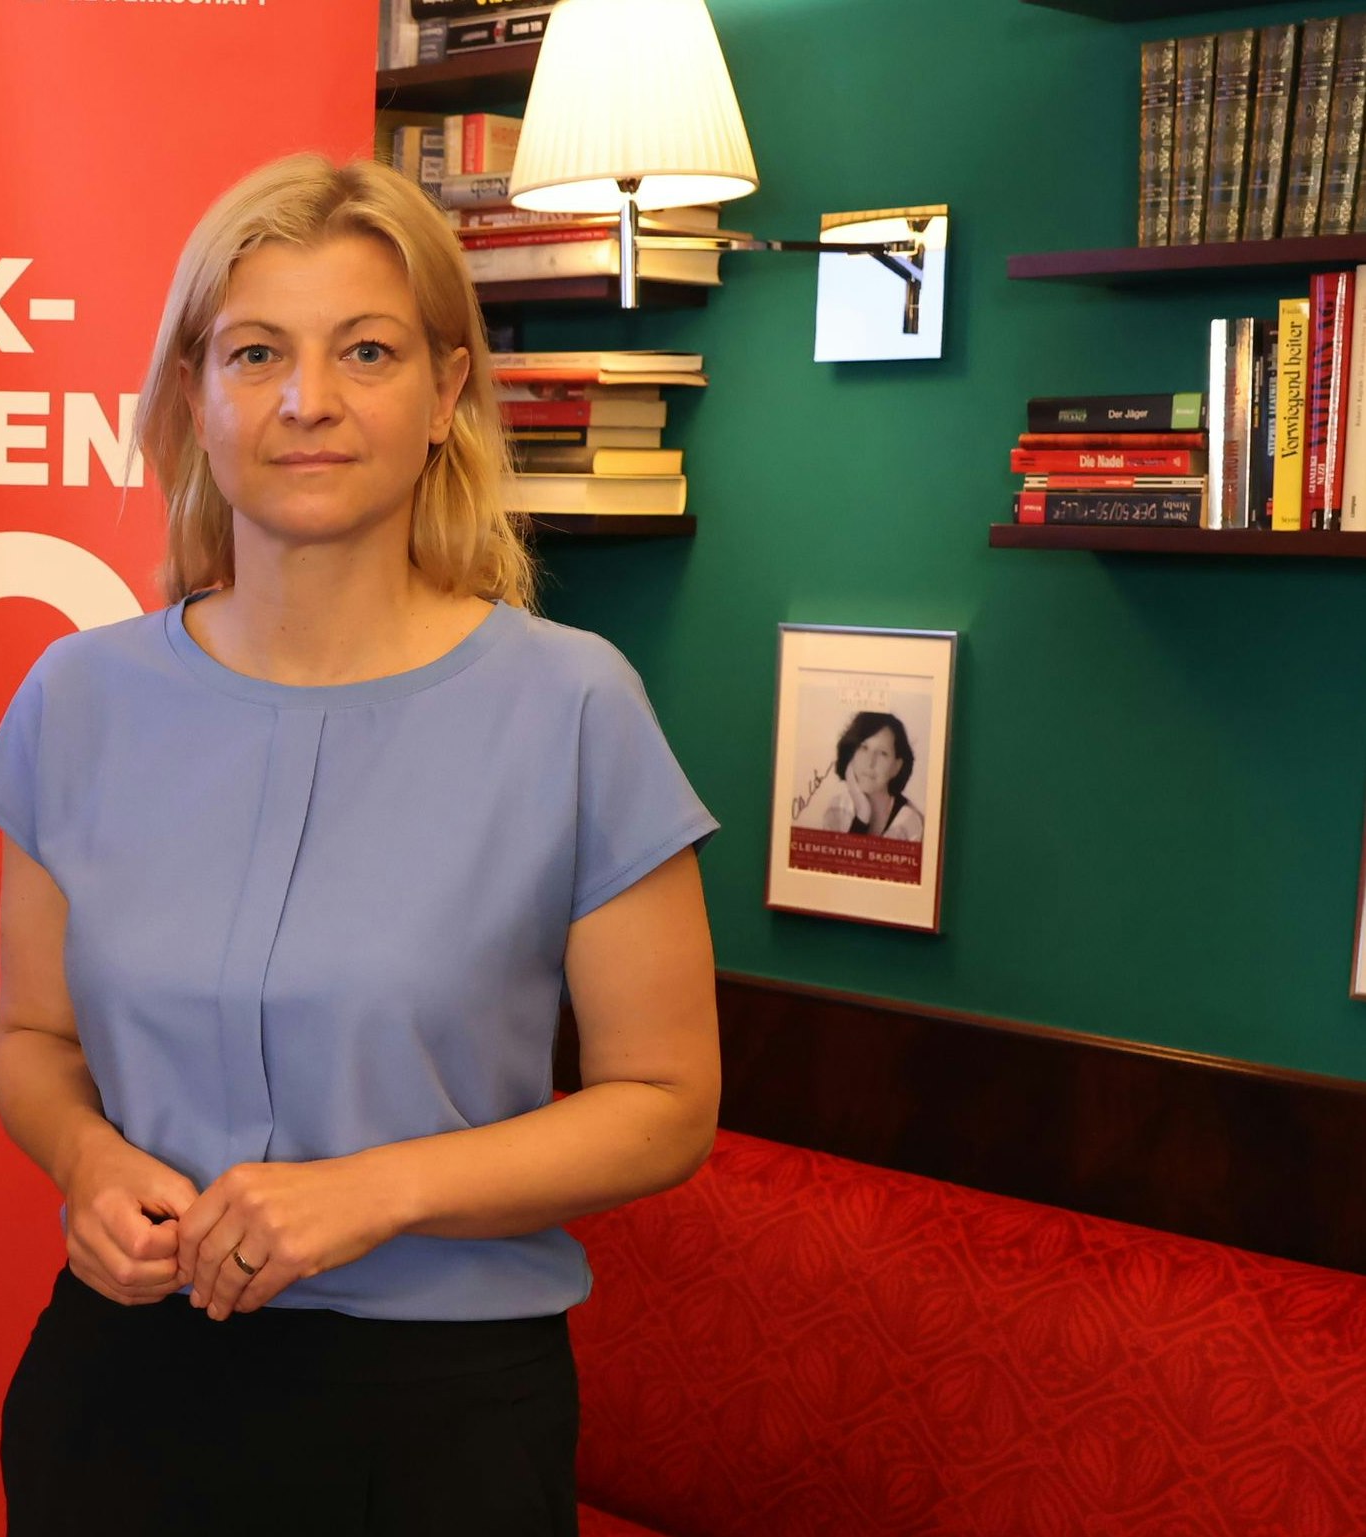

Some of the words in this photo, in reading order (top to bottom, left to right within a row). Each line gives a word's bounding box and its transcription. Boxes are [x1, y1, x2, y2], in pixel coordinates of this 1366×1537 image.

[1284, 321, 1303, 366] heiter
[1108, 409, 1123, 419] Der
[1125, 409, 1148, 421] Jäger
[1281, 370, 1304, 459] Vorwiegend
[1079, 455, 1095, 468] Die
[1097, 455, 1124, 469] Nadel
[1162, 500, 1191, 511] Mosby
[1163, 511, 1188, 522] Steve
[790, 841, 864, 859] CLEMENTINE
[868, 851, 919, 867] SKORPIL
